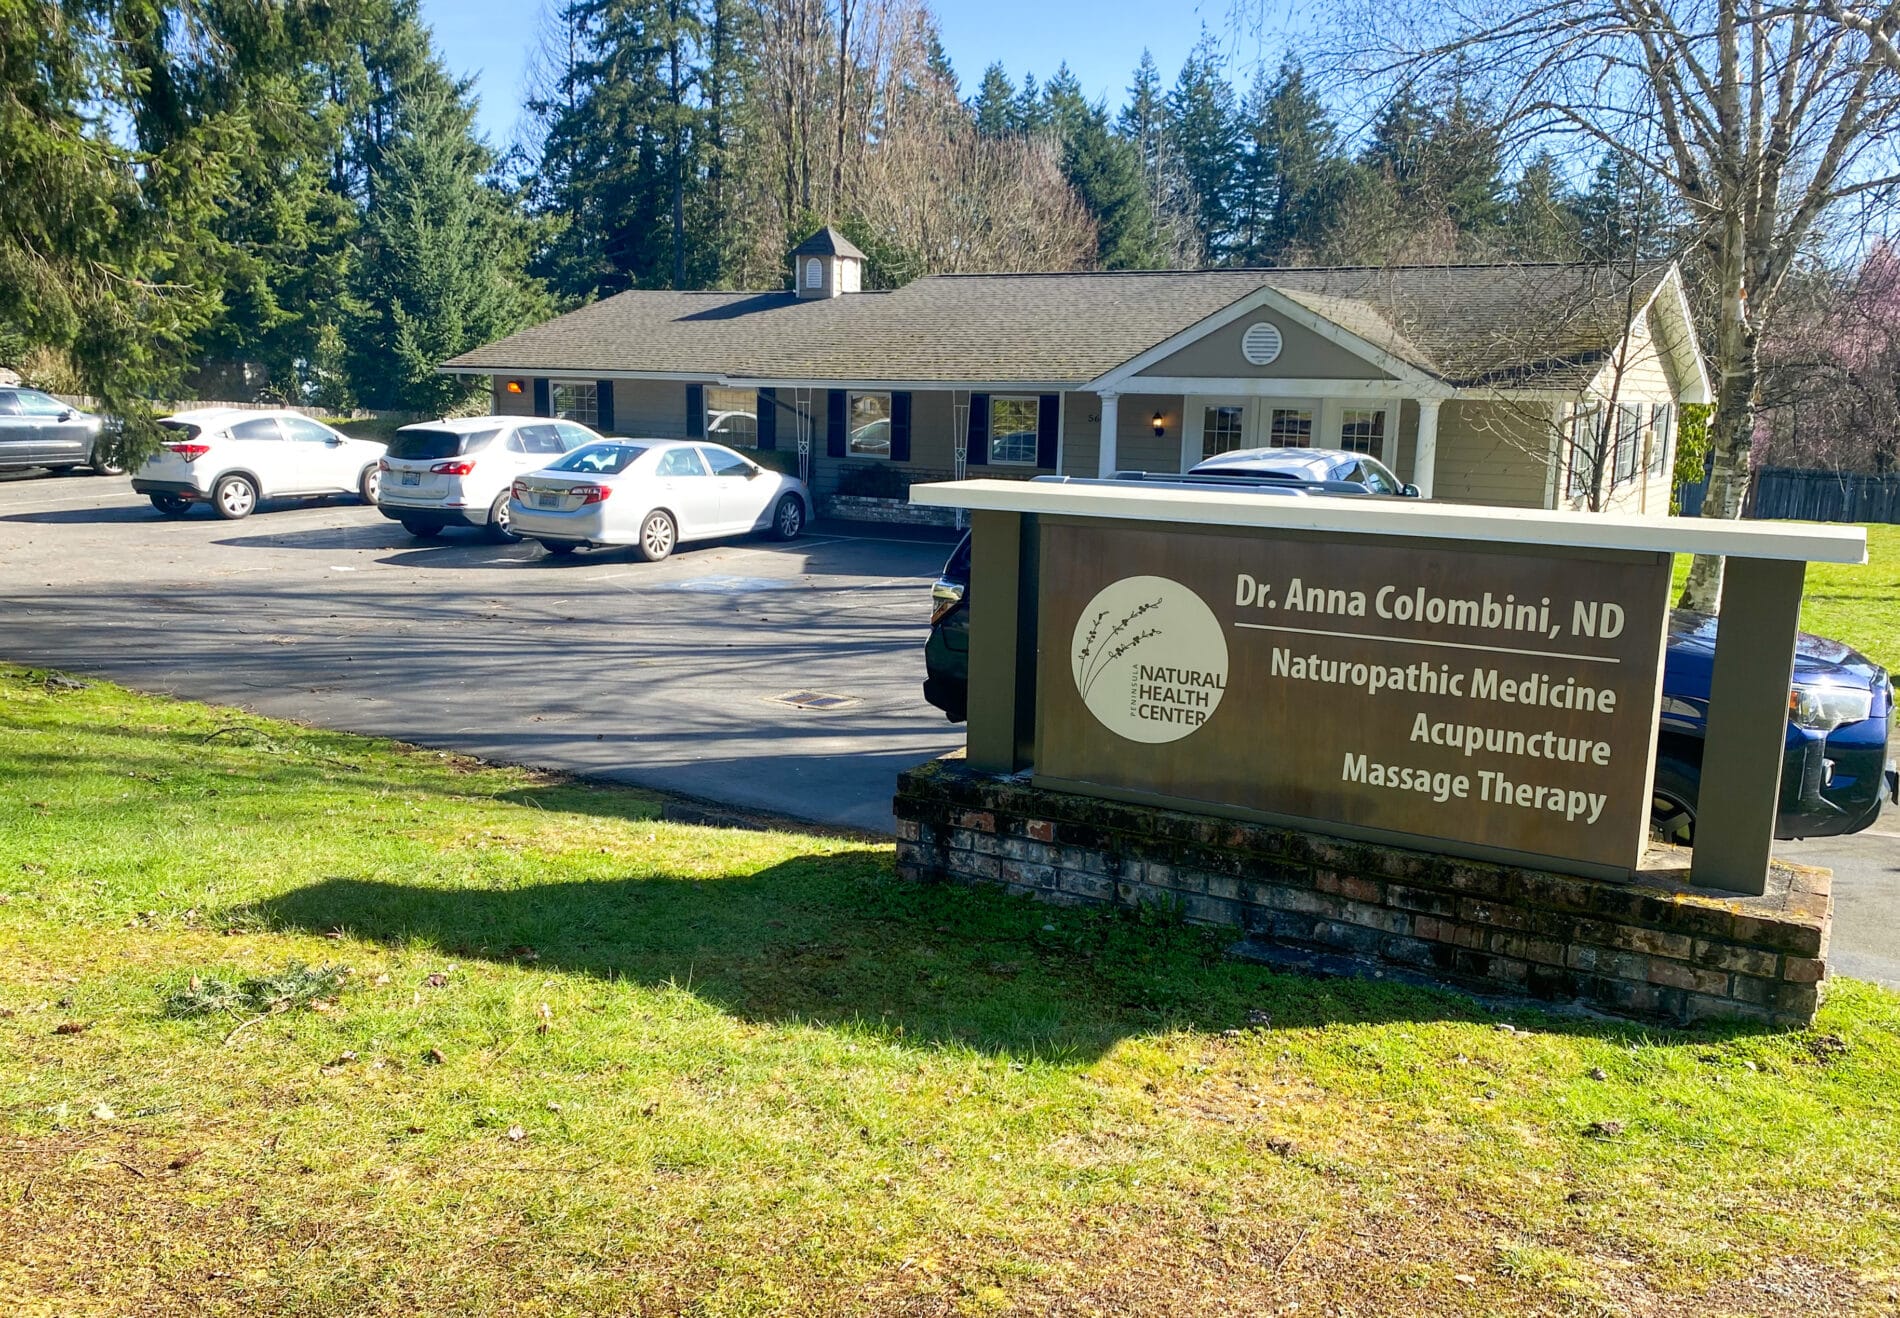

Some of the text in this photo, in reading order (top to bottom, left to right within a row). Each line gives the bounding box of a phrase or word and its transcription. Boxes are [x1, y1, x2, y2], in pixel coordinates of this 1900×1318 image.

[1236, 574, 1625, 640] Dr. Anna Colombini, ND
[1130, 664, 1139, 717] PENINSULA
[1139, 664, 1226, 690] NATURAL
[1139, 684, 1210, 708] HEALTH
[1271, 648, 1617, 714] Naturopathic Medicine
[1138, 703, 1207, 726] CENTER
[1410, 713, 1611, 766] Acupuncture
[1342, 753, 1608, 825] Massage Therapy
